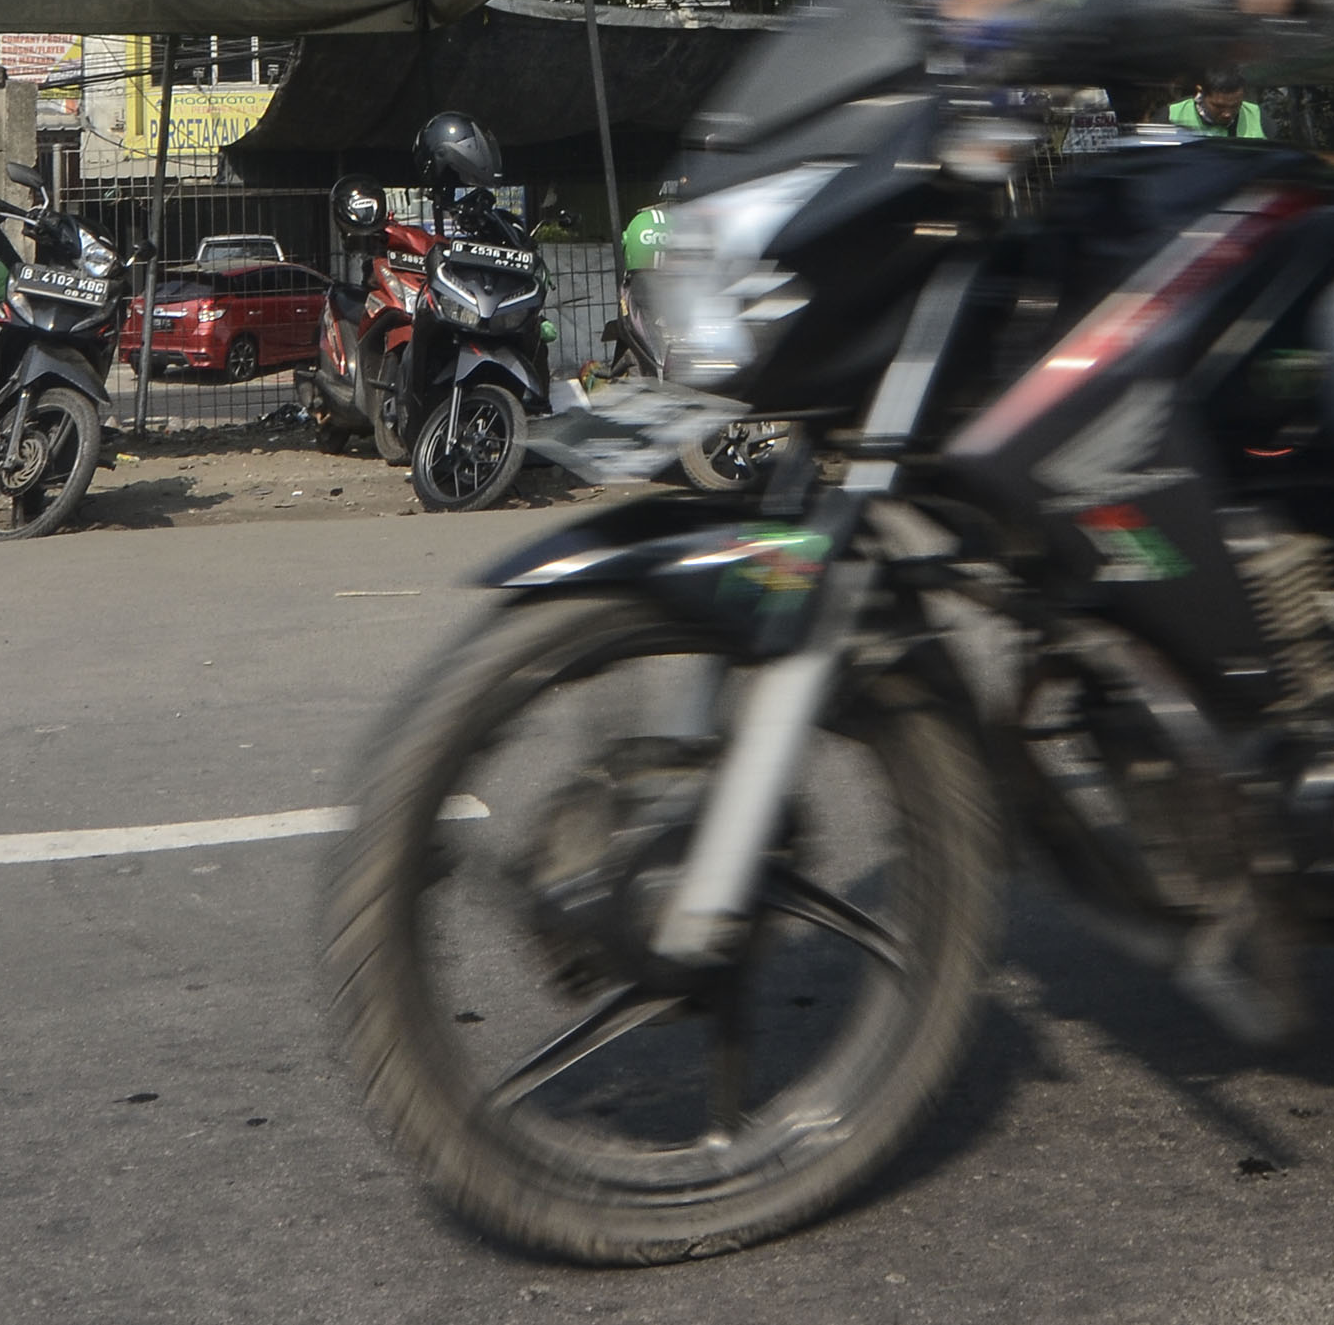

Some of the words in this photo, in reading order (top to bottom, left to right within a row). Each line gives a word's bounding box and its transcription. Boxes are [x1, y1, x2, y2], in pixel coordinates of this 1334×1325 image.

[1, 35, 39, 44] COMPANY
[150, 117, 239, 149] PRCETAKAN
[23, 267, 34, 280] B
[41, 272, 75, 287] 4102
